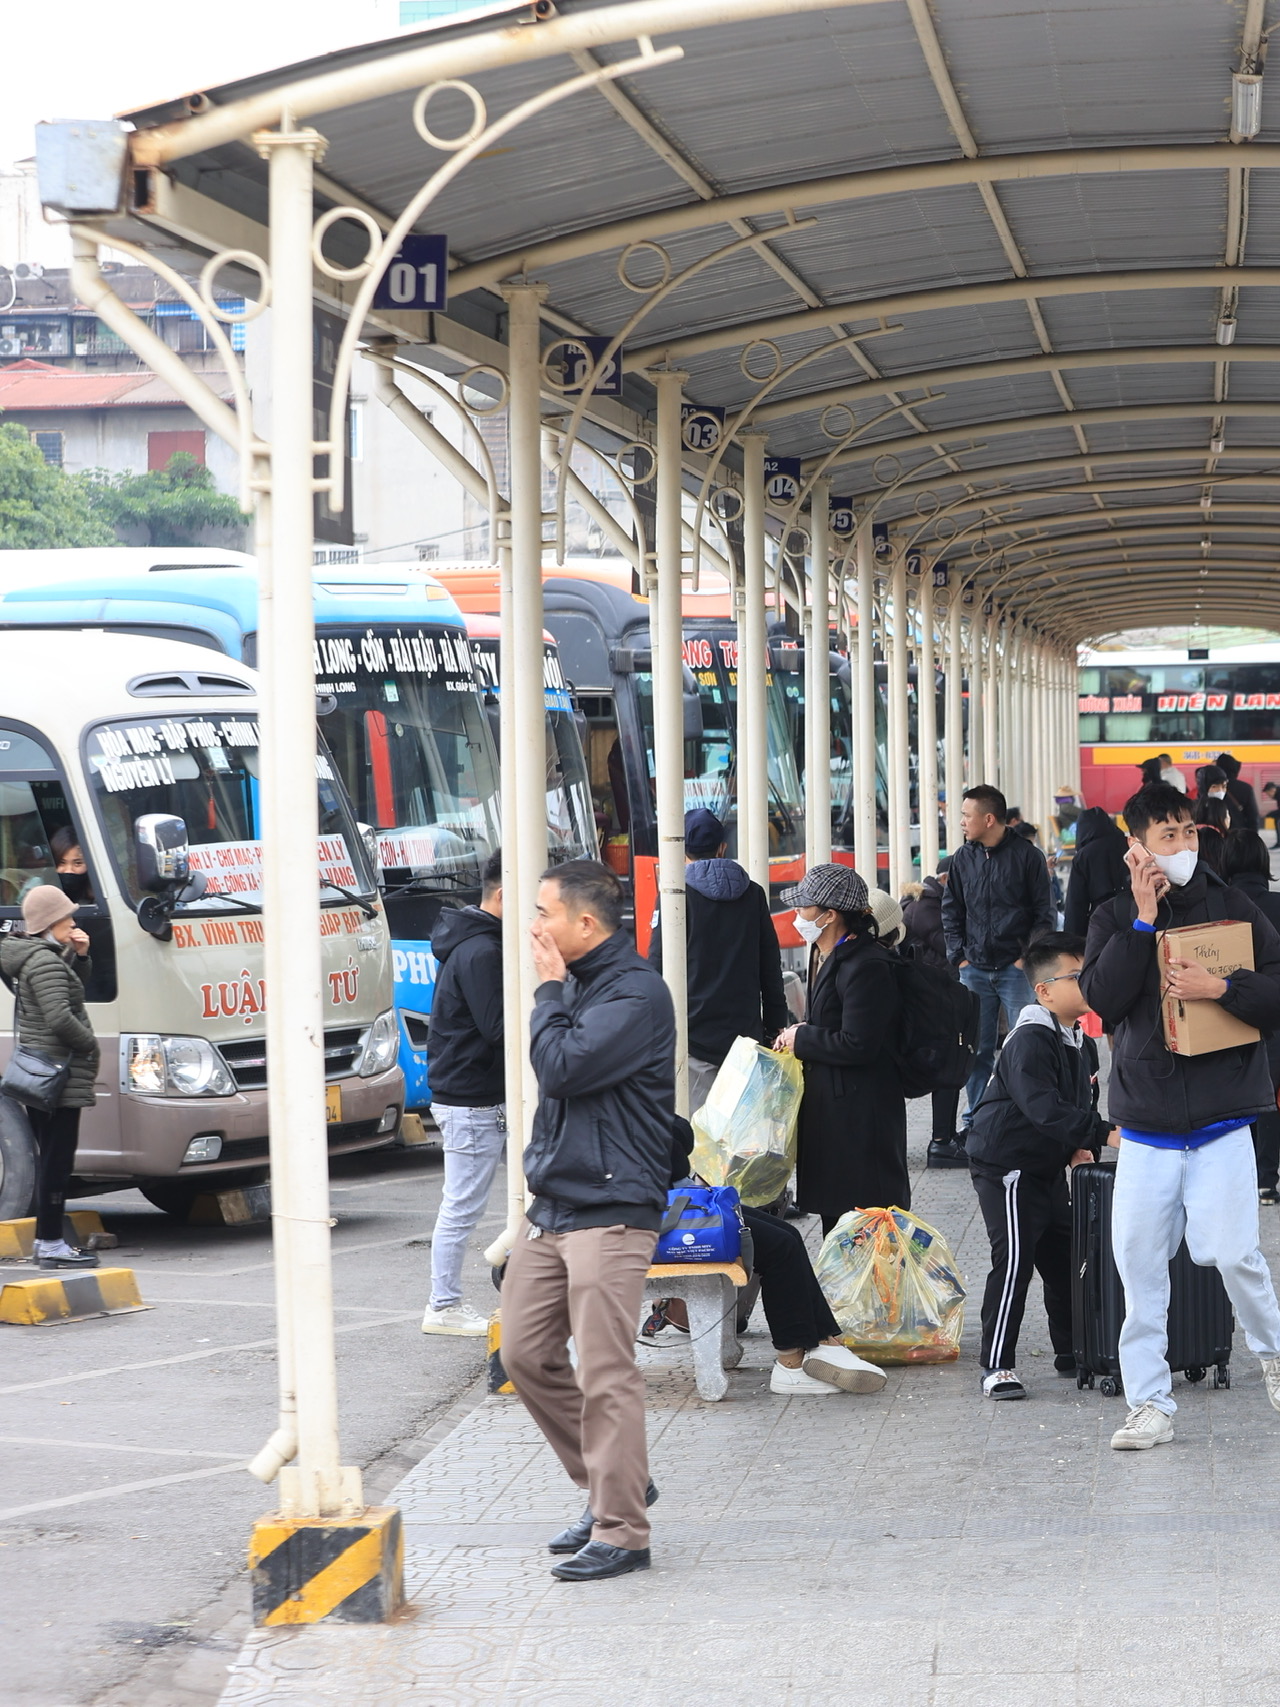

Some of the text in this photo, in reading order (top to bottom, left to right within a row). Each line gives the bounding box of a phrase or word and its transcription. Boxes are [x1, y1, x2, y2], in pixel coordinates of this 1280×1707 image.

[389, 262, 437, 304] 01
[687, 422, 719, 448] 03
[764, 462, 779, 472] A2
[768, 478, 797, 498] 04
[323, 638, 357, 675] LONG
[335, 682, 357, 693] LONG
[101, 756, 160, 793] NGUYÊN
[172, 924, 202, 949] BX.
[201, 918, 239, 946] VĨNH
